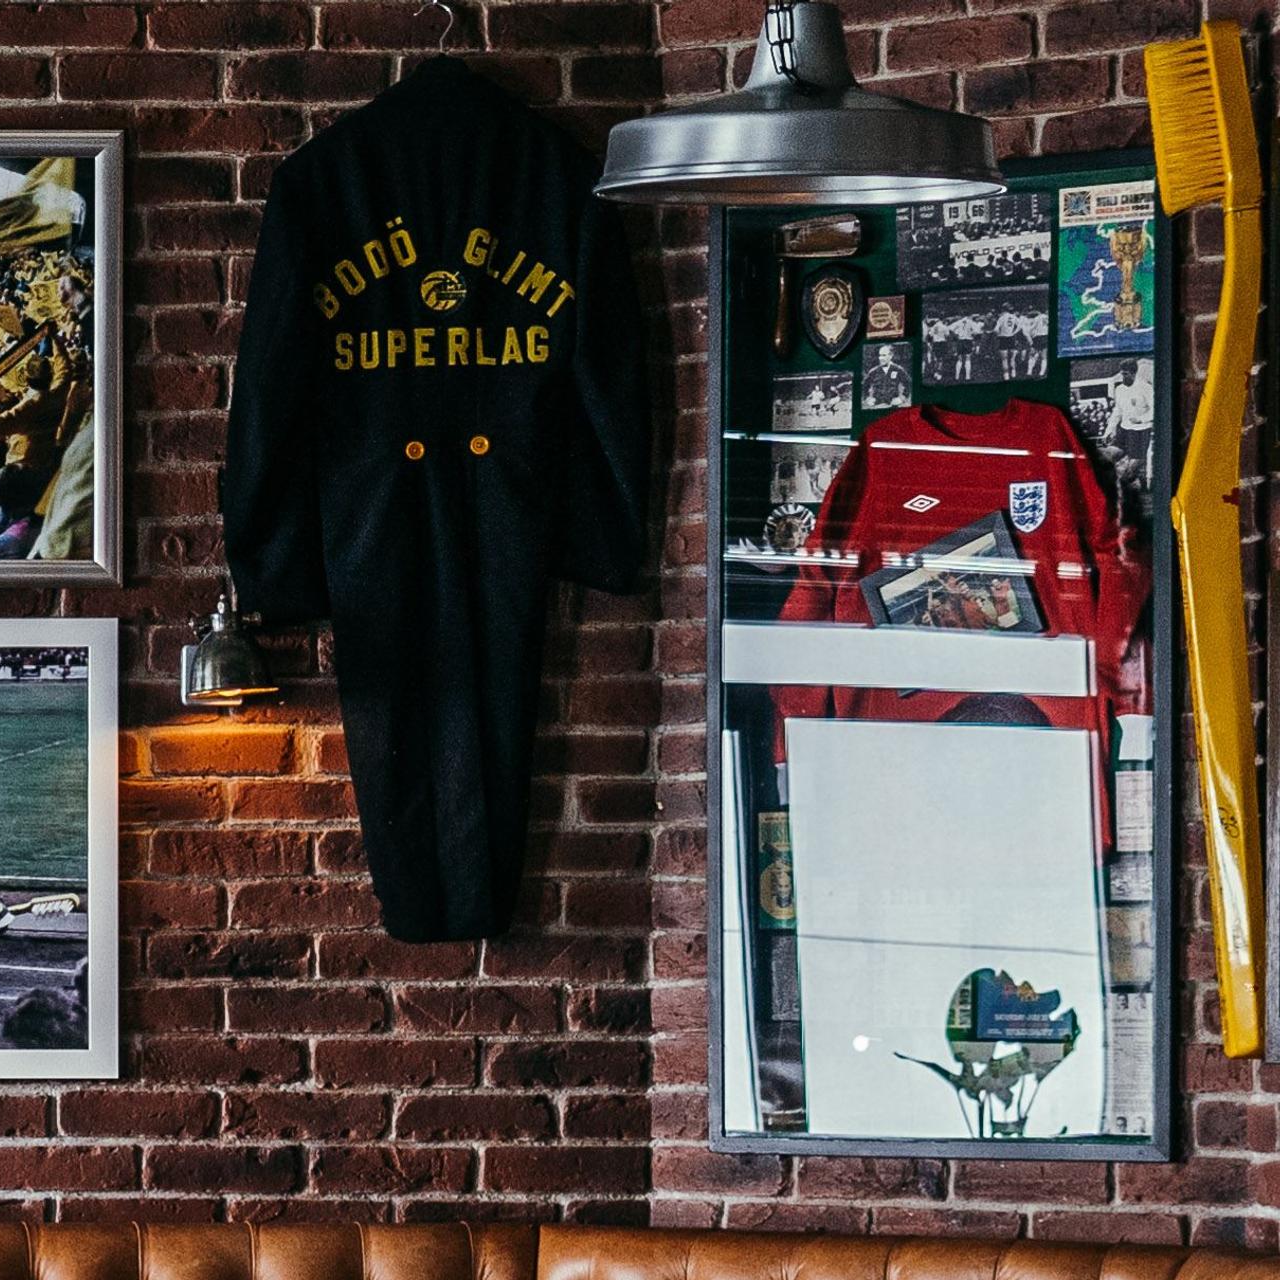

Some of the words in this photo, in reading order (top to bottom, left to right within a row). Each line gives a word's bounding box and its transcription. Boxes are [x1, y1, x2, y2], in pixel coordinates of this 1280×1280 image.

[313, 216, 417, 321] BODÖ
[463, 227, 576, 318] GLIMT
[951, 248, 990, 259] WORLD
[334, 325, 550, 371] SUPERLAG
